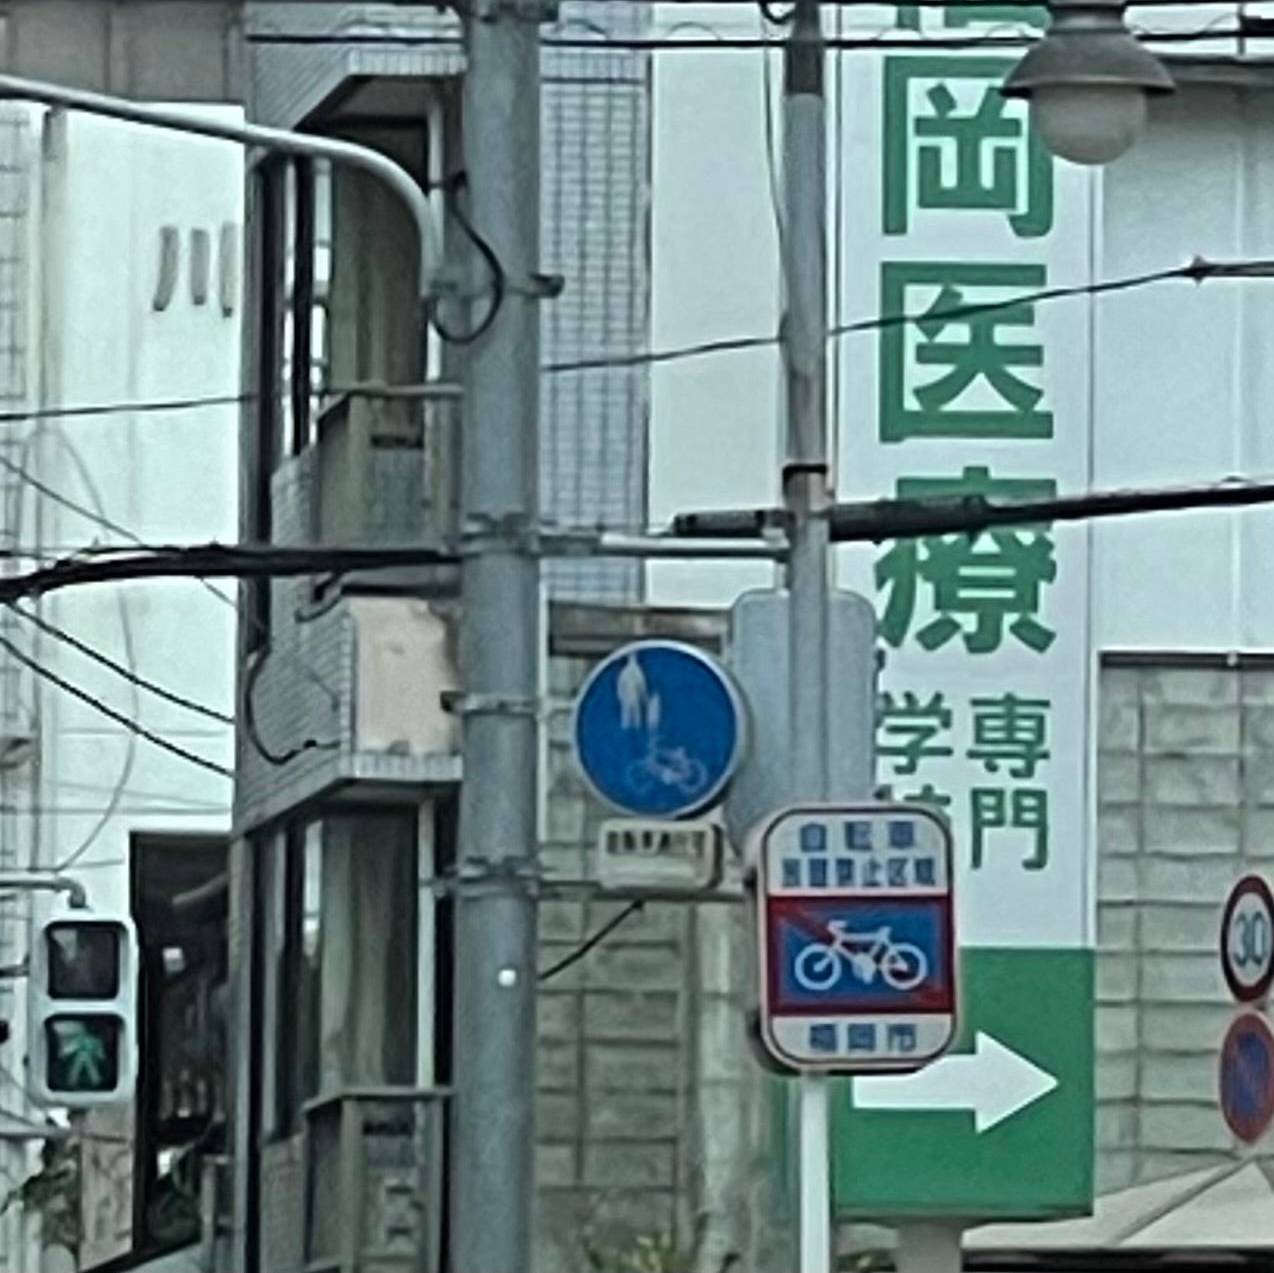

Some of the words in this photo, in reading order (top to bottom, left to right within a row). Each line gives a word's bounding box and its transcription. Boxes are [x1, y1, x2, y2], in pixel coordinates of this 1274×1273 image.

[874, 691, 953, 818] 学
[967, 692, 1051, 870] 専門
[1233, 910, 1268, 966] 30
